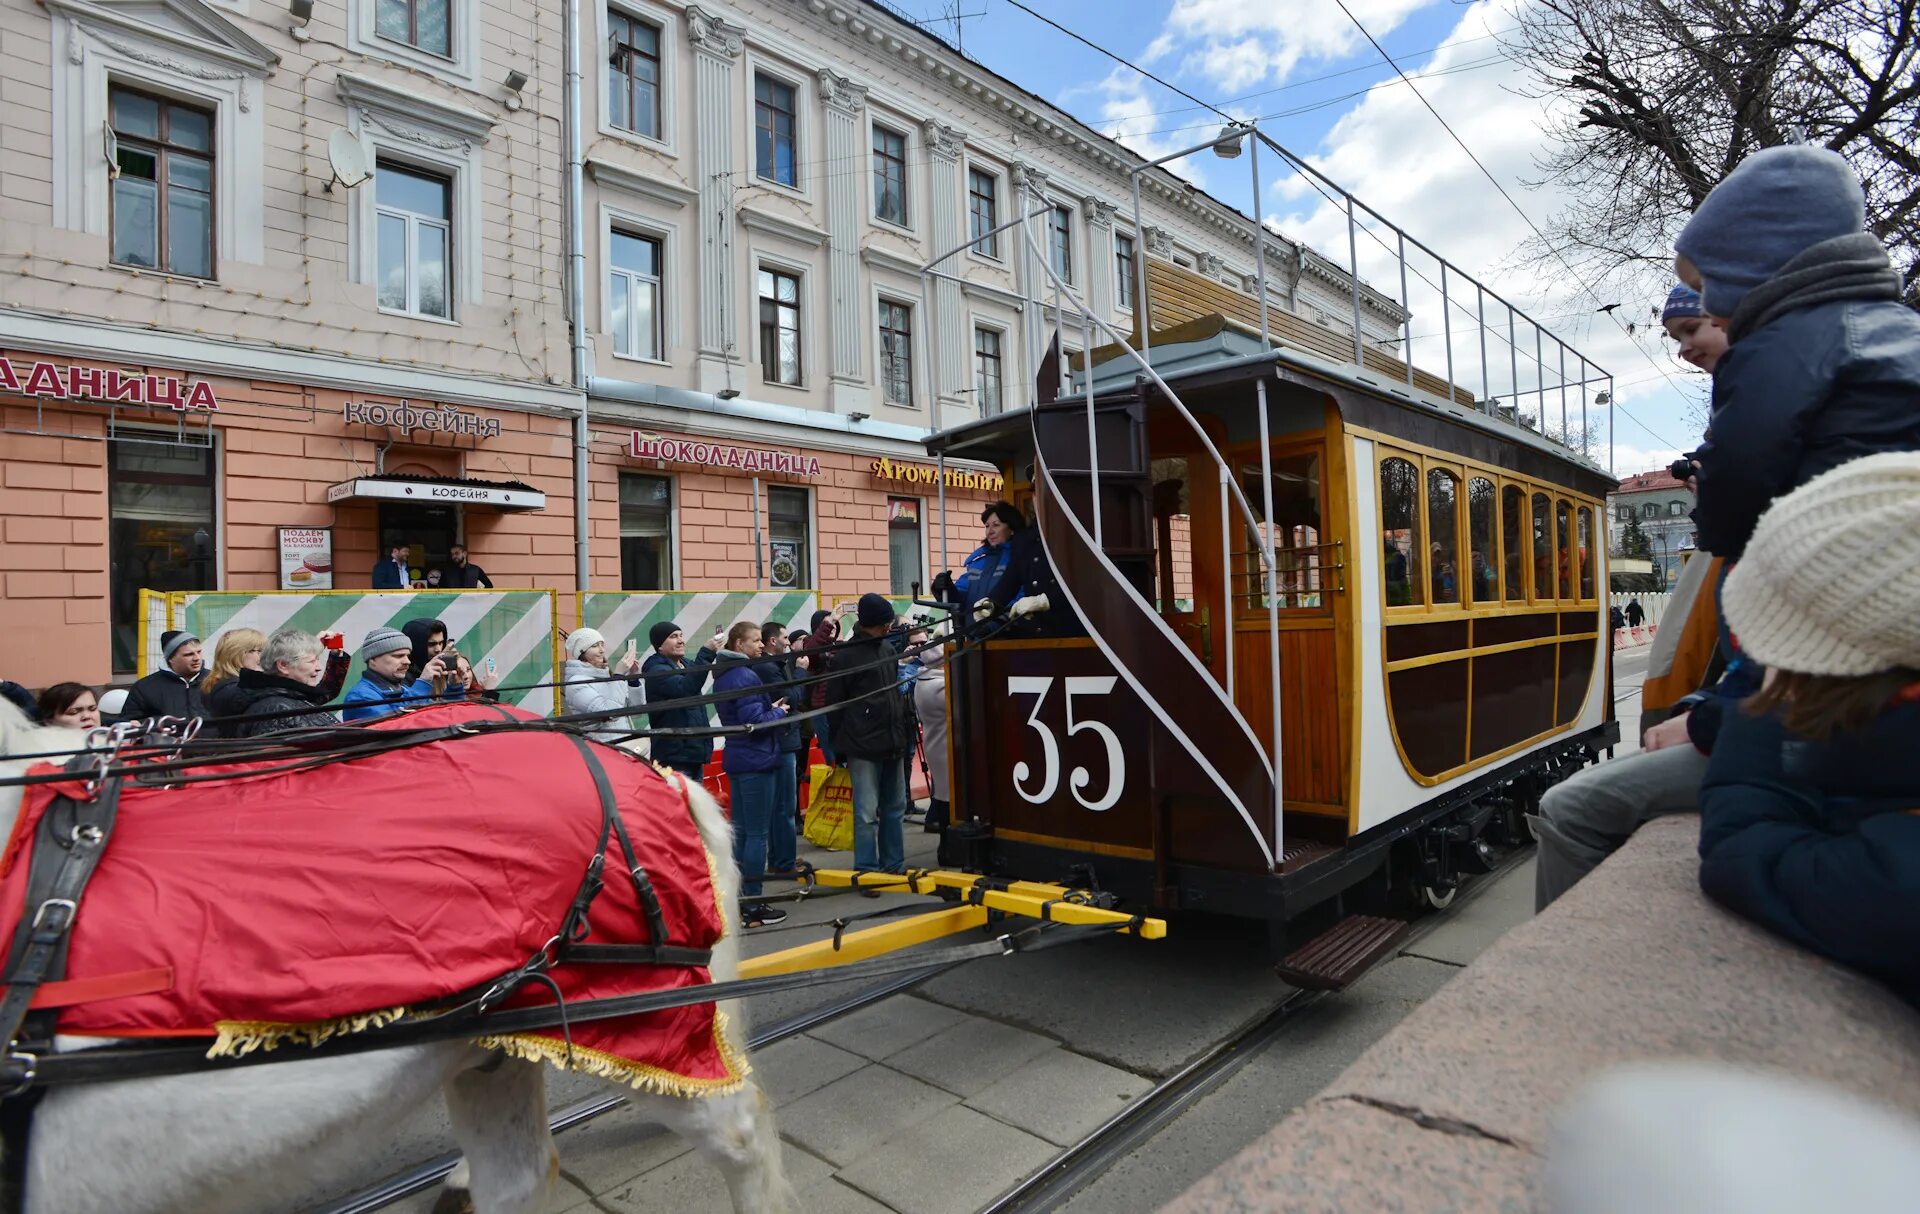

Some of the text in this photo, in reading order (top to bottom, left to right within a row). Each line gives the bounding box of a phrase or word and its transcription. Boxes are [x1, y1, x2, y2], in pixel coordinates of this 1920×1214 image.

[343, 400, 501, 437] кофейня
[432, 487, 488, 499] КОФЕЙНЯ
[1007, 675, 1125, 811] 35
